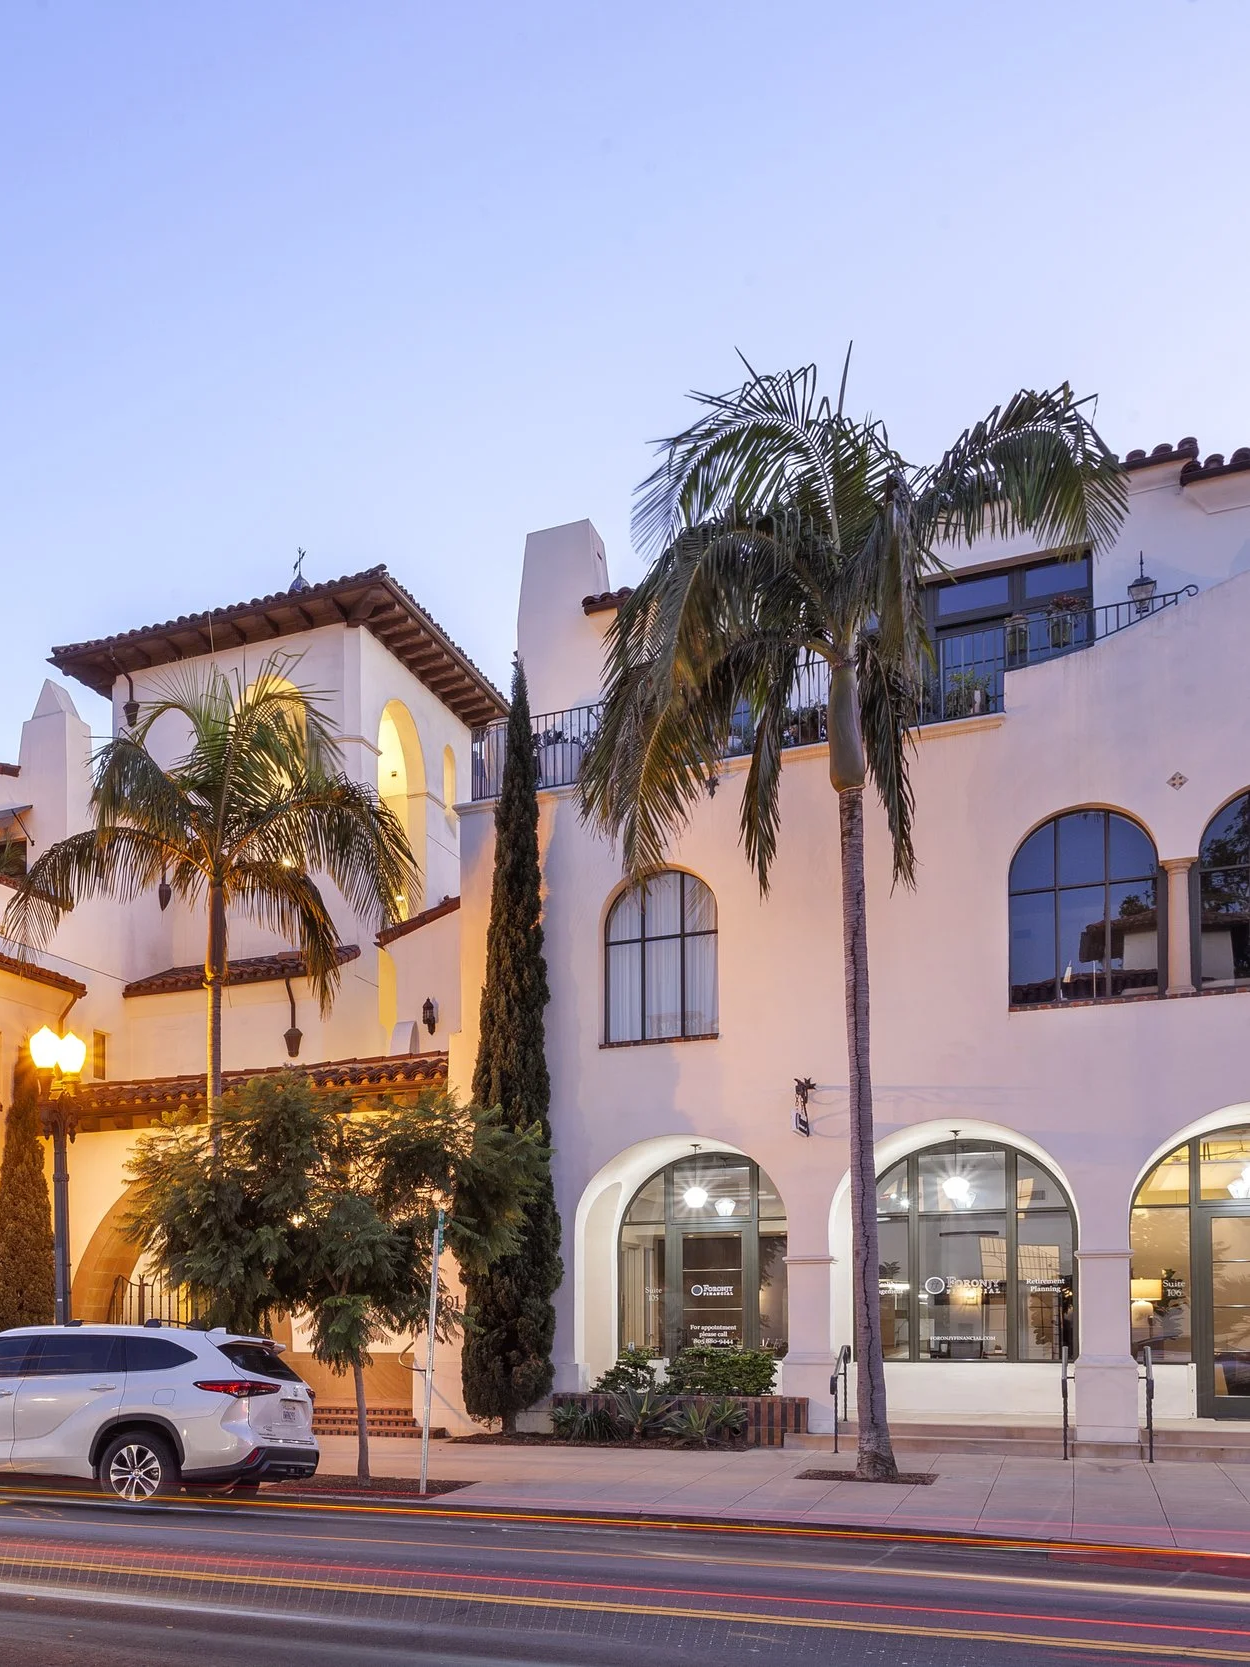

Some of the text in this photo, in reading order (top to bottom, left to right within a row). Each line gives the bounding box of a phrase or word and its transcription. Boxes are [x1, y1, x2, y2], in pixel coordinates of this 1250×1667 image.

[946, 1276, 999, 1289] FORONJY
[1162, 1279, 1186, 1288] Suite
[644, 1286, 663, 1294] Suite
[1030, 1285, 1062, 1293] Planning
[1166, 1288, 1182, 1297] 106
